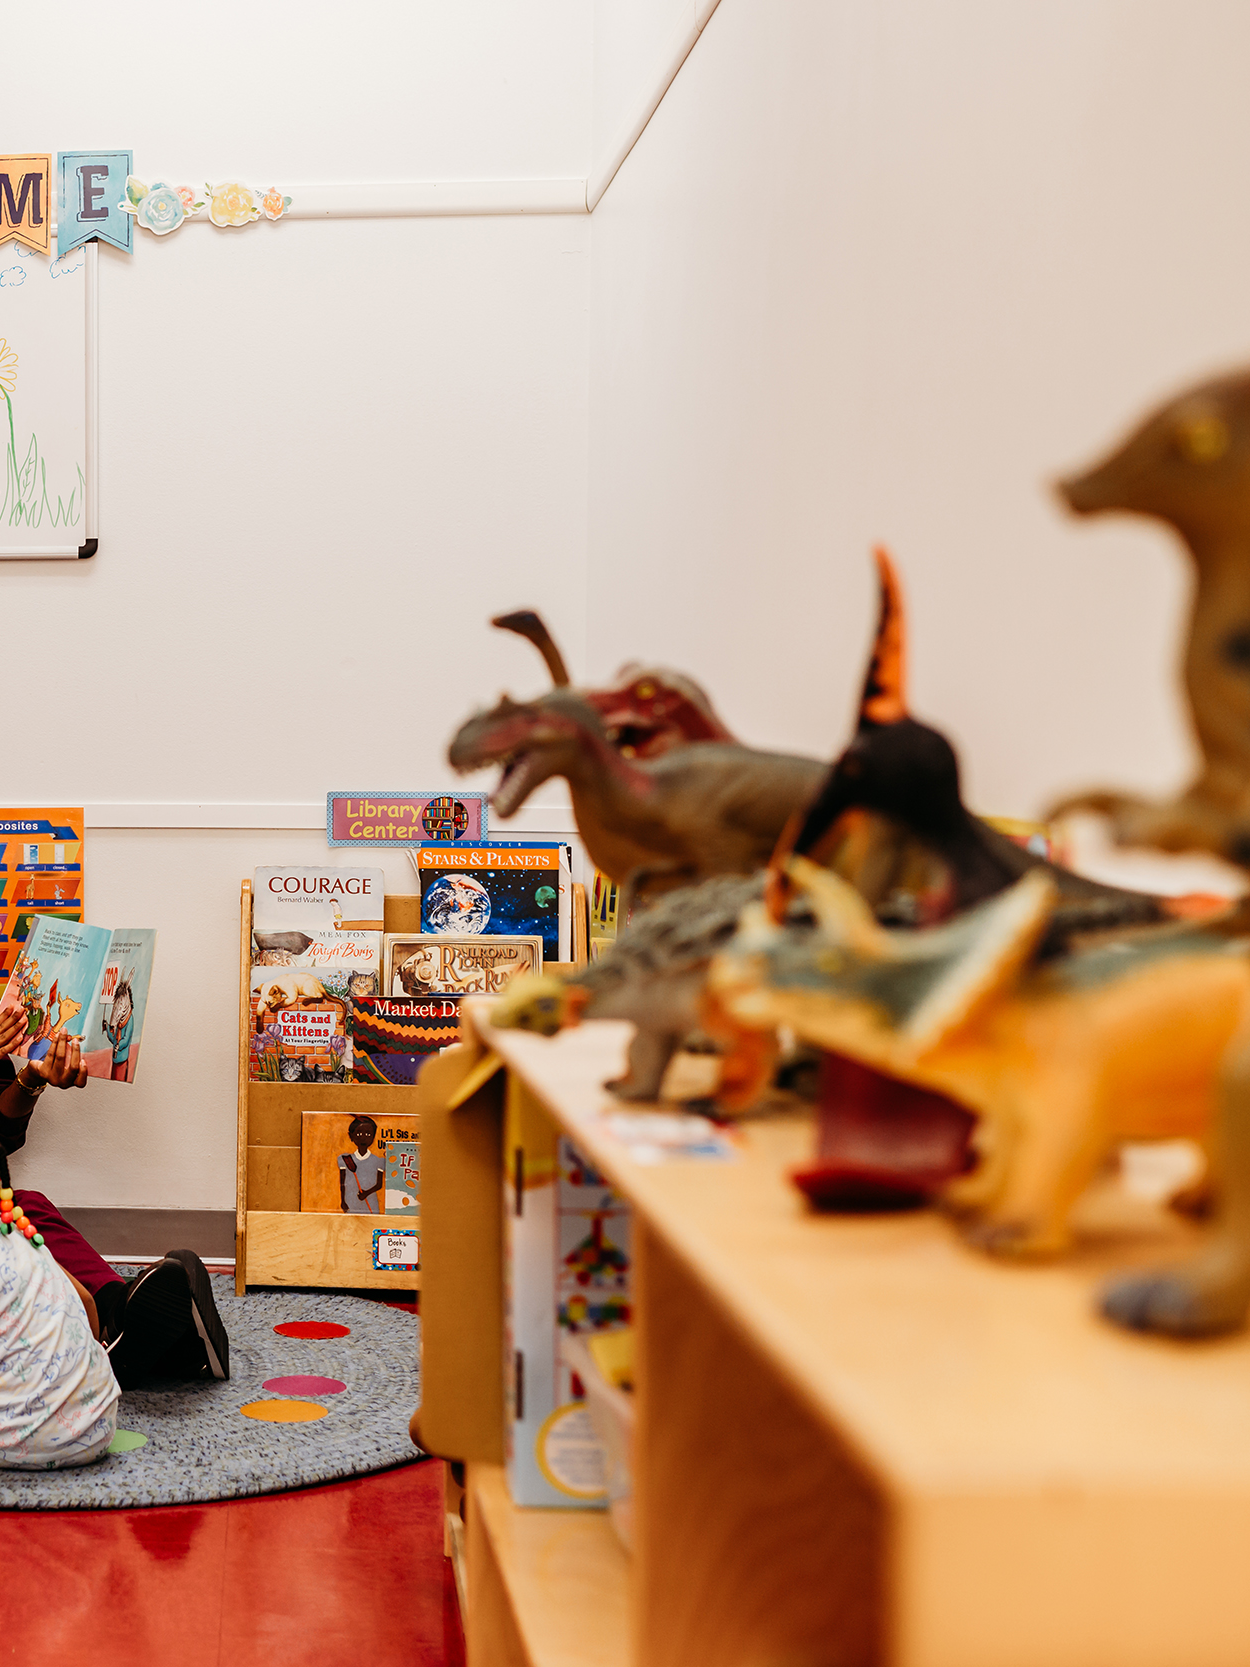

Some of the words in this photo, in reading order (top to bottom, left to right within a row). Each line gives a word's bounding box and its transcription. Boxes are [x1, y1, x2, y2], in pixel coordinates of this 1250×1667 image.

[346, 800, 422, 823] Library
[349, 821, 419, 839] Center
[422, 851, 467, 865] STARS
[469, 852, 484, 865] &
[486, 852, 550, 866] PLANETS
[268, 876, 372, 895] COURAGE
[308, 942, 340, 964] Tough
[340, 942, 375, 961] Boris
[437, 945, 518, 983] RAILROAD
[458, 957, 495, 970] JOHN
[101, 967, 118, 996] STOP
[373, 1000, 437, 1016] Market
[280, 1011, 308, 1024] Cats
[310, 1013, 331, 1024] and
[282, 1025, 330, 1037] Kittens
[387, 1237, 407, 1247] Books
